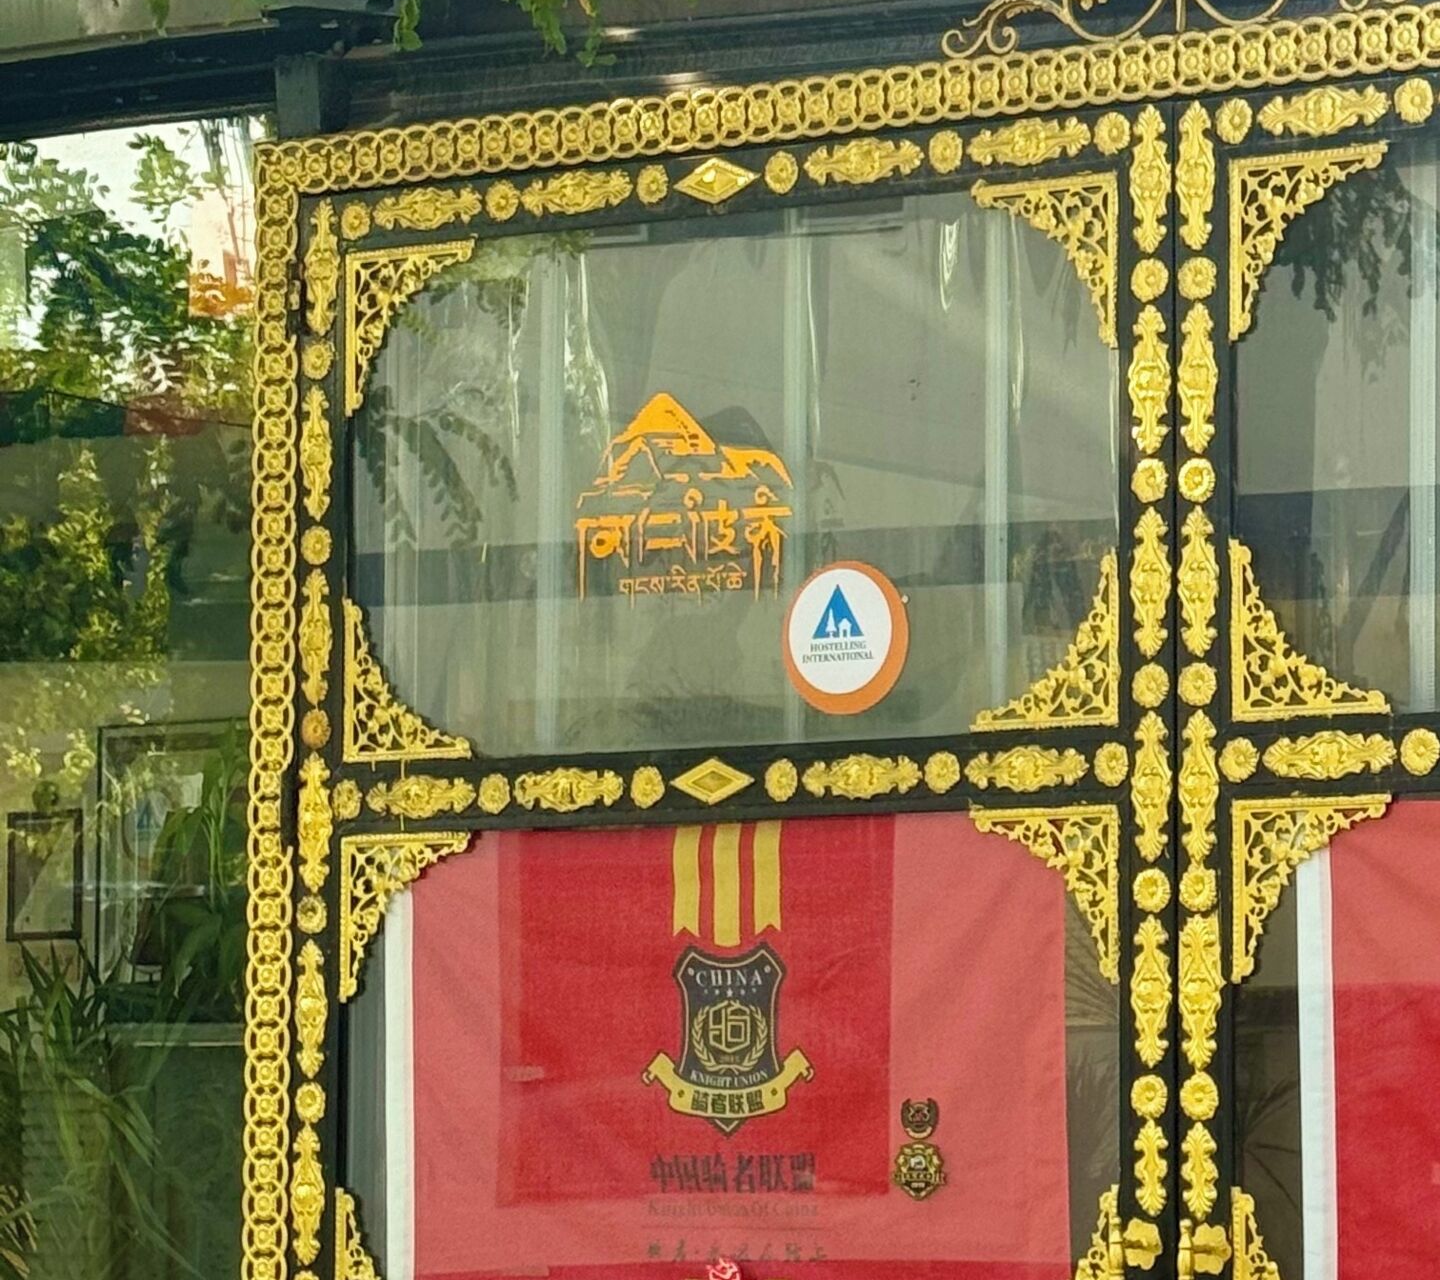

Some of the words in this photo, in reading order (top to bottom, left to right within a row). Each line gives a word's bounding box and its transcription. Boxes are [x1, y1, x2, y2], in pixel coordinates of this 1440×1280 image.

[810, 641, 867, 653] HOSTELLING
[802, 650, 874, 664] INTERNATIONAL
[695, 969, 763, 987] CHINA
[691, 1089, 766, 1115] 骑者联盟
